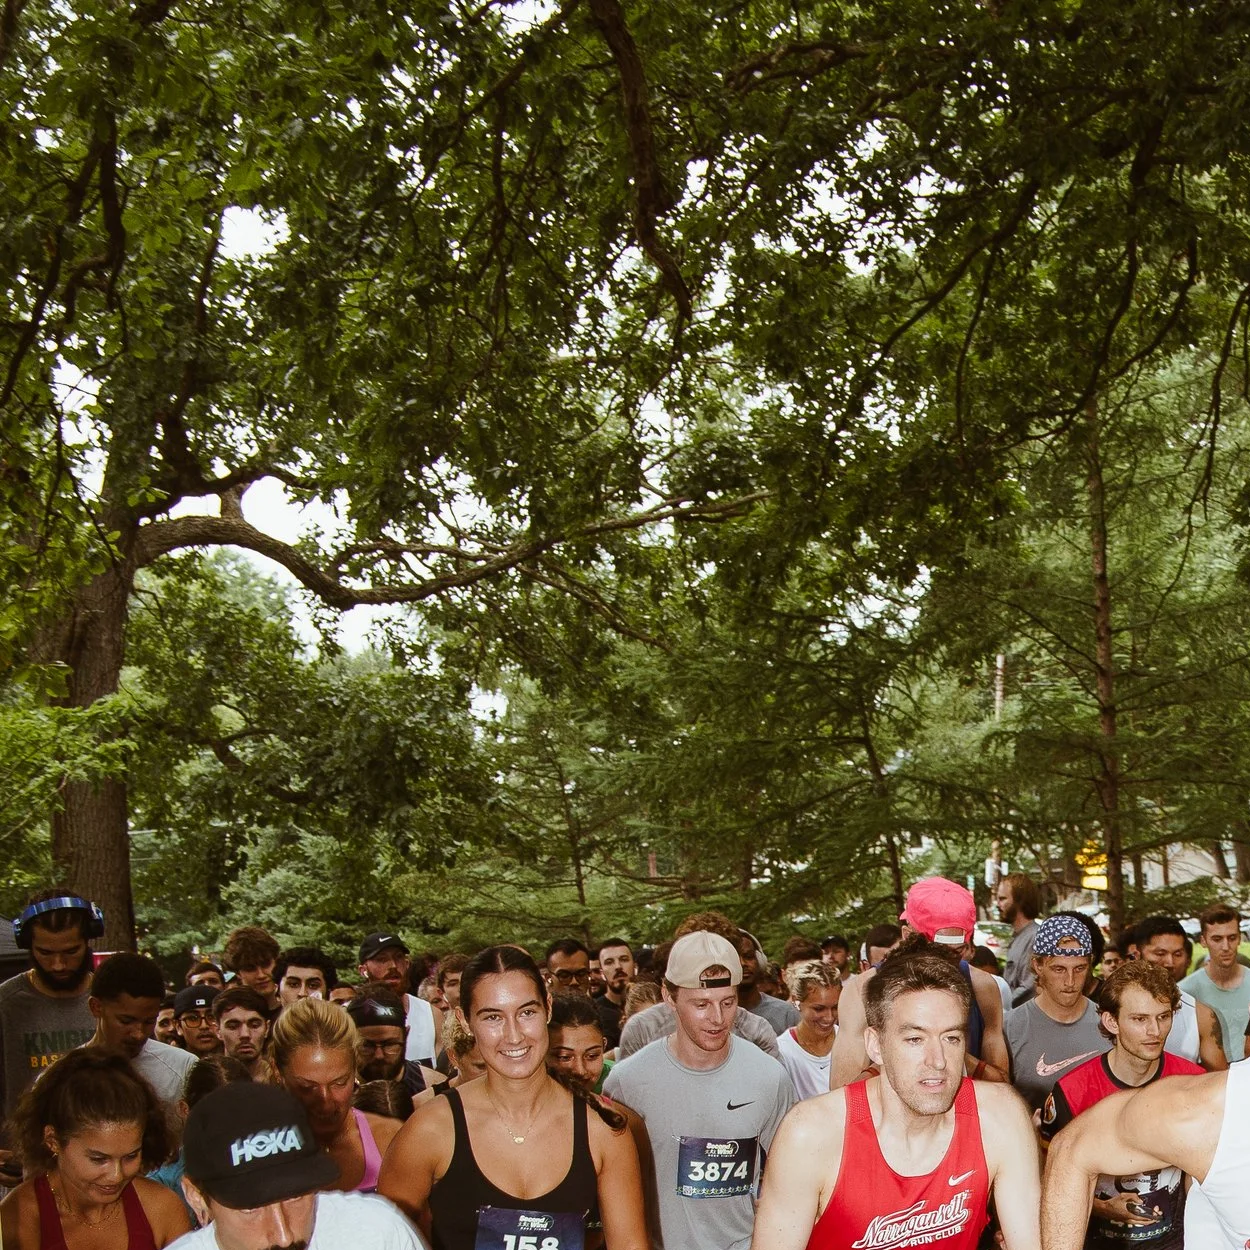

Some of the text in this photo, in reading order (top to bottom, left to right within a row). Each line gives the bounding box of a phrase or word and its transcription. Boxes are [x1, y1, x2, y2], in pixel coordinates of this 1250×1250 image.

[30, 1053, 65, 1068] BAS
[231, 1125, 304, 1166] HOKA
[688, 1161, 748, 1182] 3874
[910, 1225, 961, 1247] RUN CLUB
